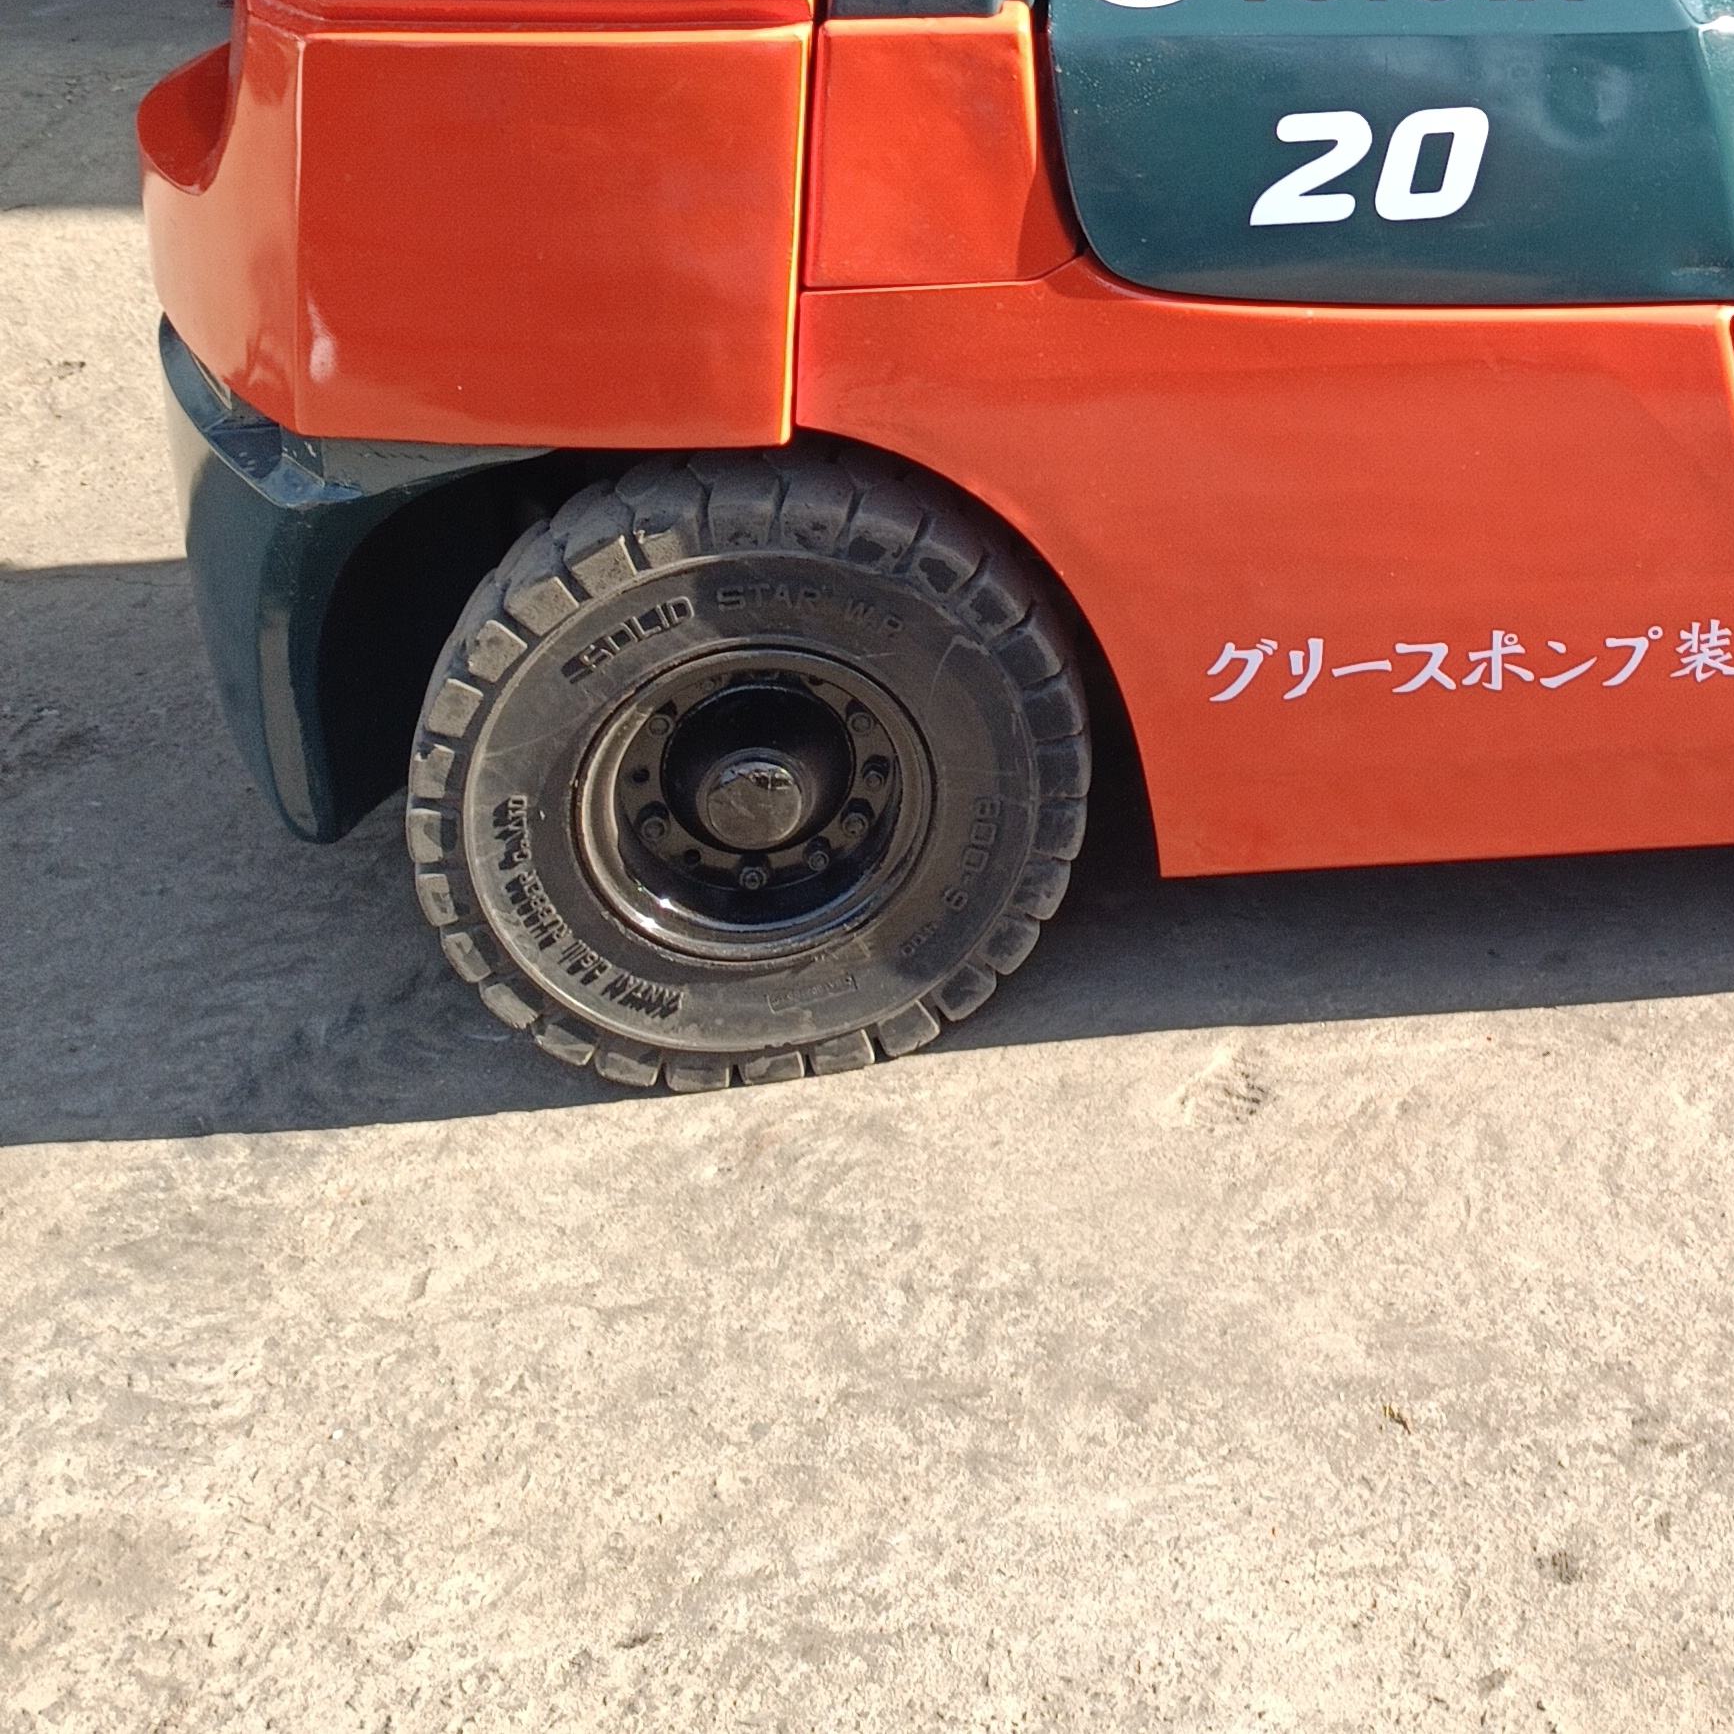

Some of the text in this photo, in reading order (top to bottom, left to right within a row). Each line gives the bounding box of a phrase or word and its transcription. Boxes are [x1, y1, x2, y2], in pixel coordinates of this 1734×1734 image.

[1249, 106, 1490, 227] 20
[570, 595, 696, 674] SOLID
[715, 584, 823, 613] STAR
